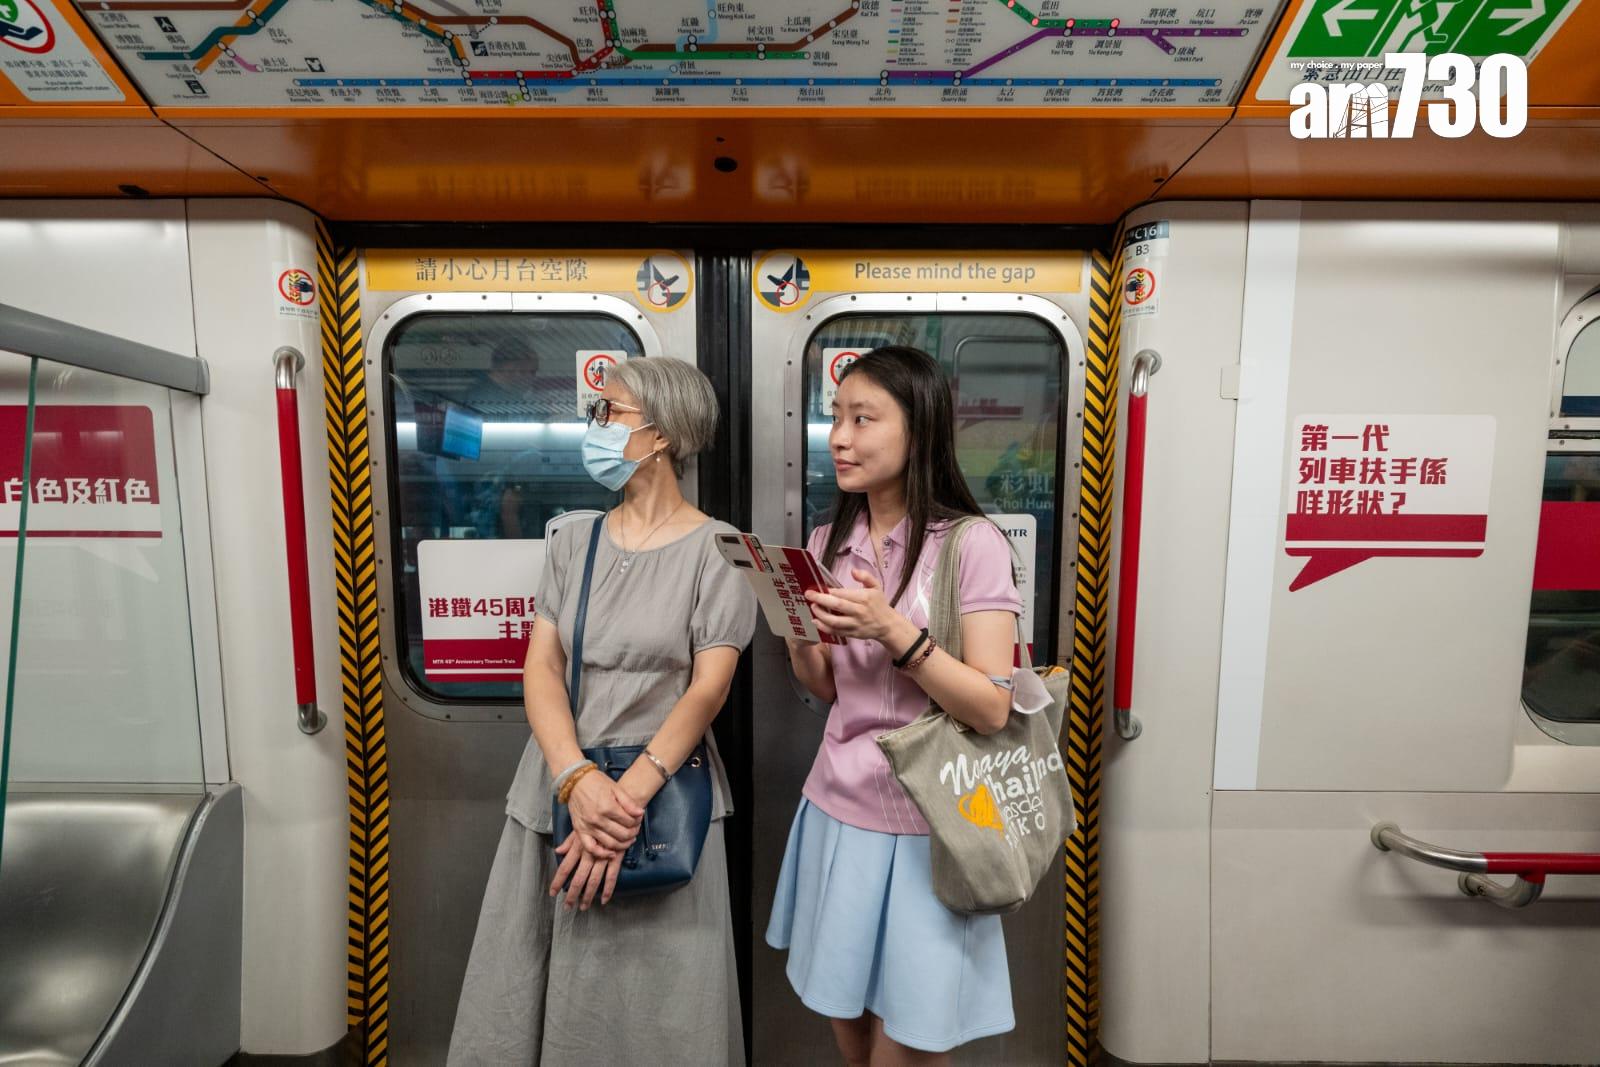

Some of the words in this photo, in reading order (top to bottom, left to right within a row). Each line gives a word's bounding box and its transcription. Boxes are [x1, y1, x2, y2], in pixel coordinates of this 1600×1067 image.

[415, 258, 588, 282] 請小心月台空隙
[855, 262, 912, 280] Please
[917, 262, 963, 280] mind
[967, 262, 997, 280] the
[1002, 266, 1036, 284] gap
[1301, 424, 1389, 451] 第一代
[1299, 457, 1448, 485] 列車扶手係
[4, 478, 151, 505] 白色及紅色
[1026, 498, 1055, 511] Hun
